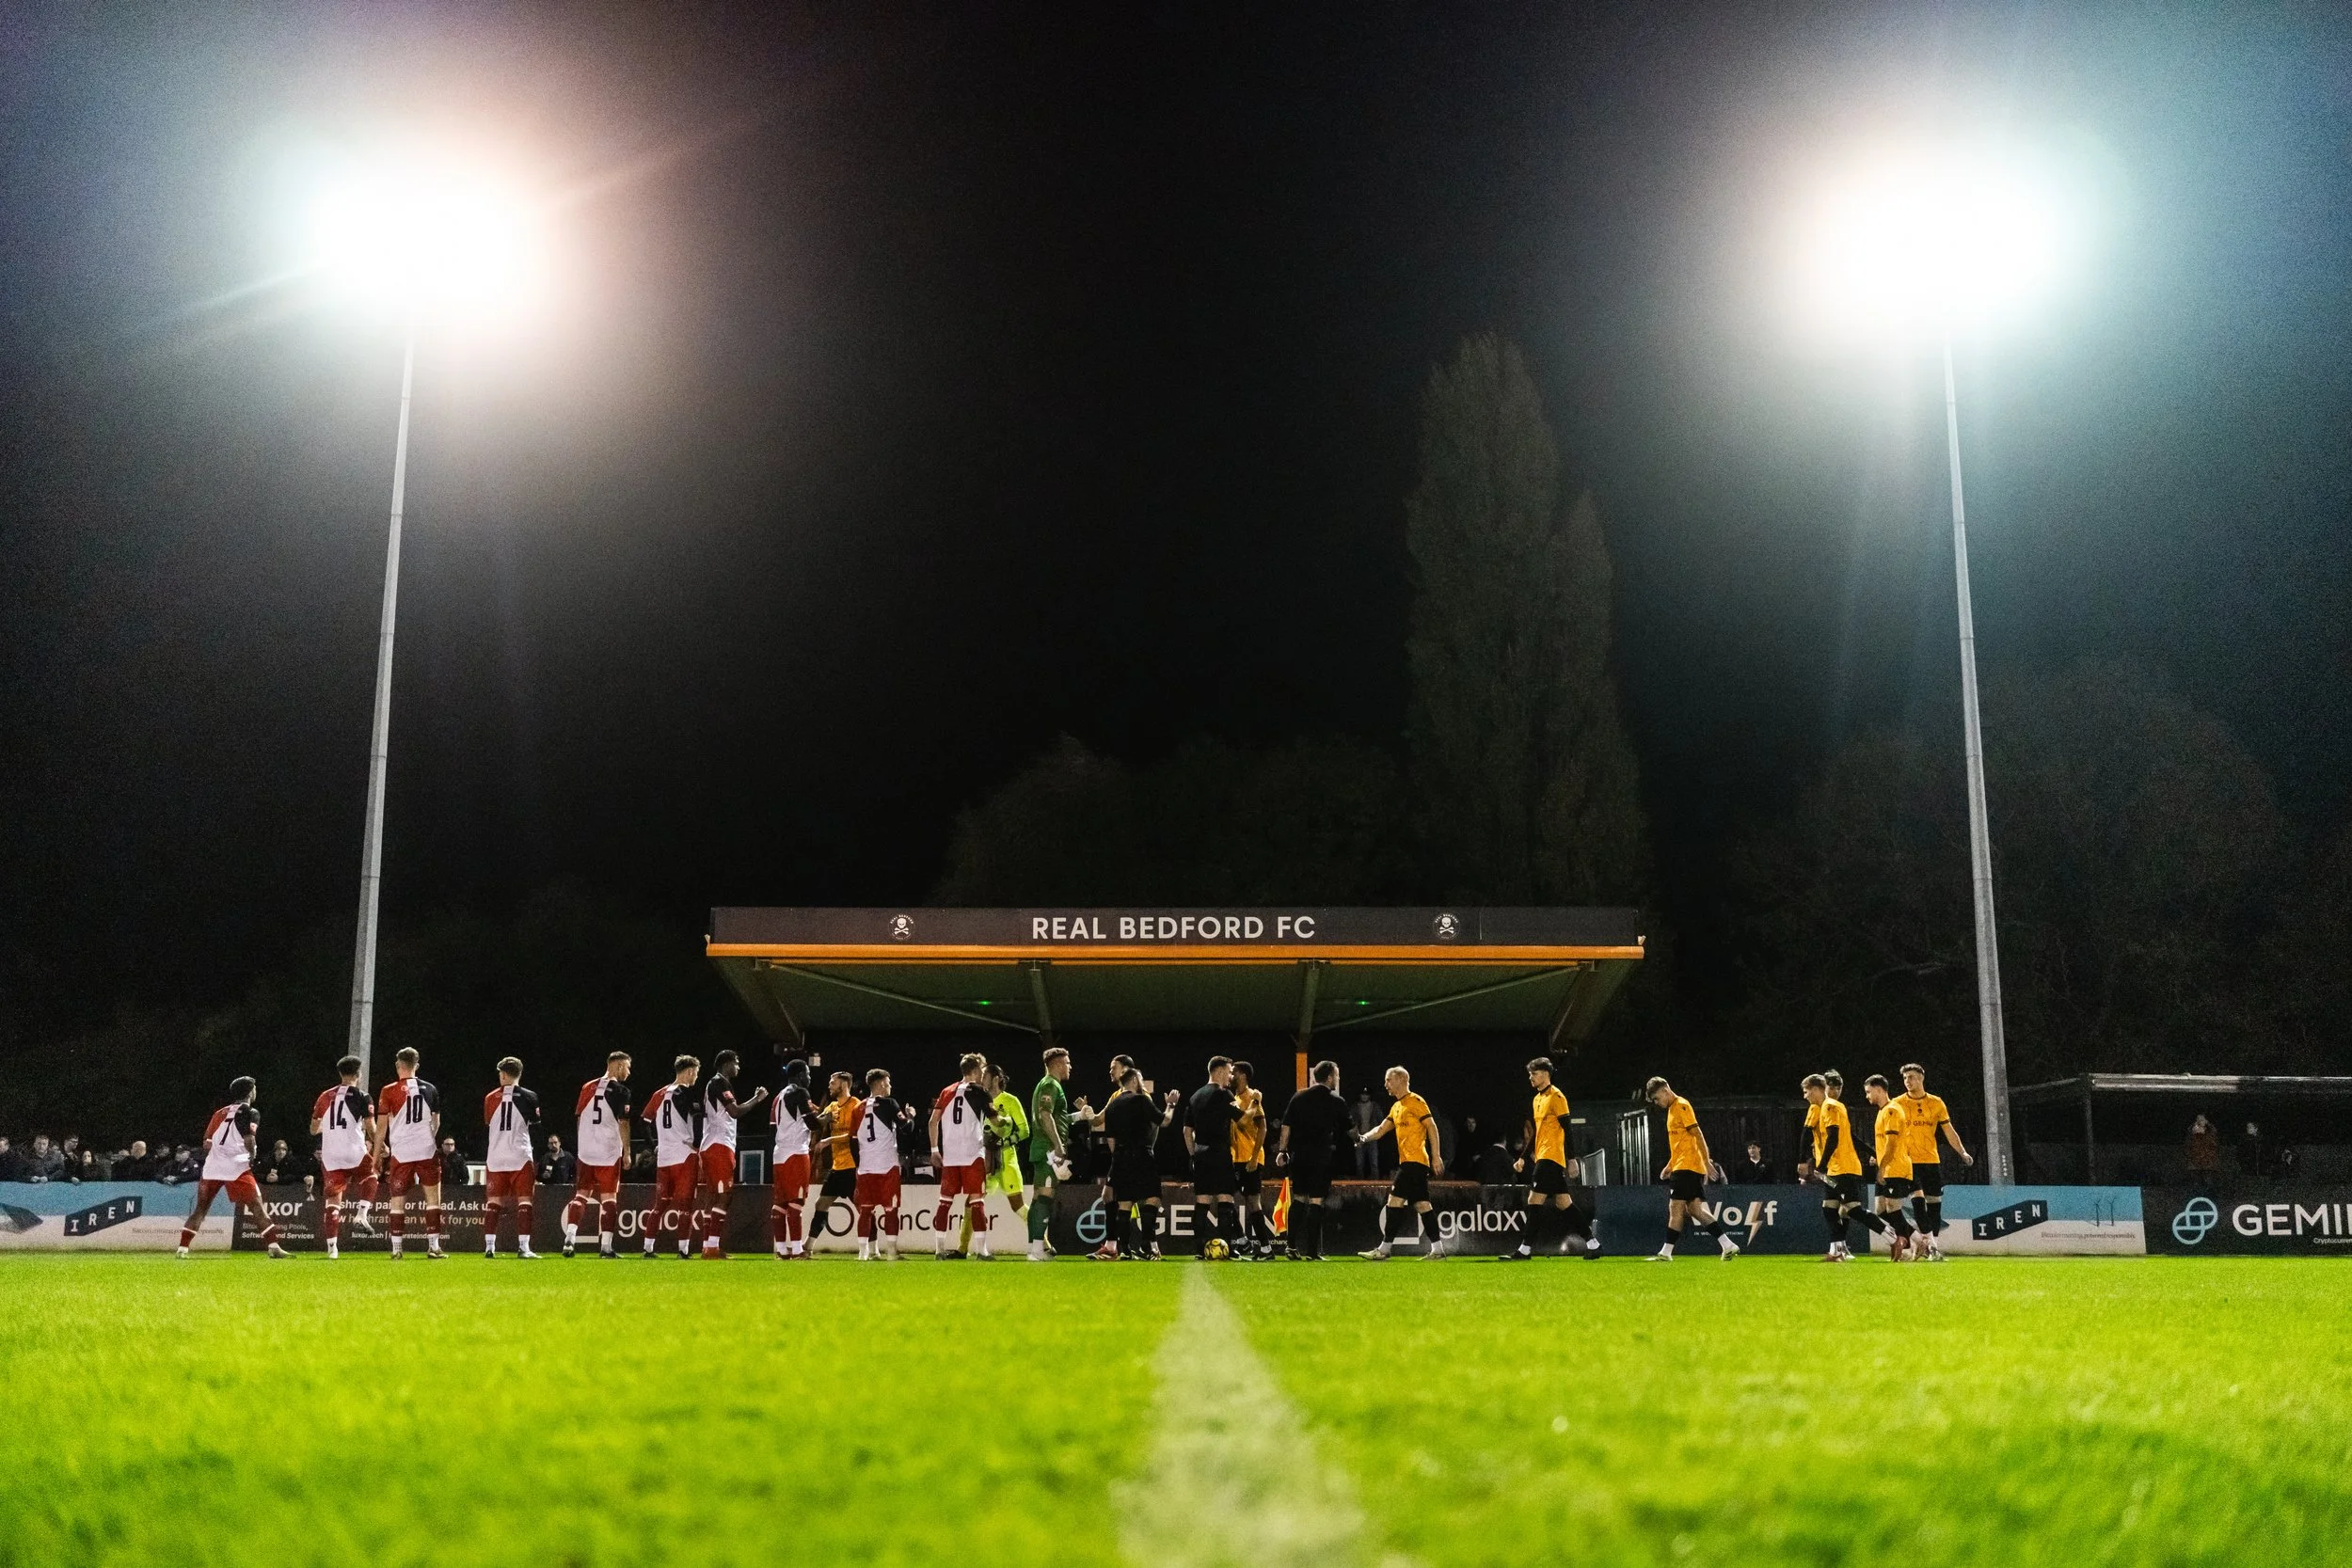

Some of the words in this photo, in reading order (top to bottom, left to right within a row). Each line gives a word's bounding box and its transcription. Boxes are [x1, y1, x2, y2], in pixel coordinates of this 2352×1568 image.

[1032, 917, 1106, 939] REAL
[1120, 916, 1263, 939] BEDFORD
[1278, 916, 1315, 939] FC
[330, 1100, 346, 1129] 14
[406, 1095, 422, 1124] 10
[500, 1101, 513, 1131] 11
[592, 1095, 604, 1124] 5
[662, 1100, 672, 1129] 8
[953, 1096, 963, 1124] 6
[219, 1117, 234, 1145] 7
[865, 1113, 876, 1142] 3
[71, 1200, 135, 1232] IREN
[375, 1199, 391, 1212] pai
[459, 1201, 479, 1211] Ask
[1979, 1204, 2041, 1236] IREN
[405, 1215, 417, 1224] an
[449, 1214, 463, 1225] for
[466, 1216, 485, 1227] you
